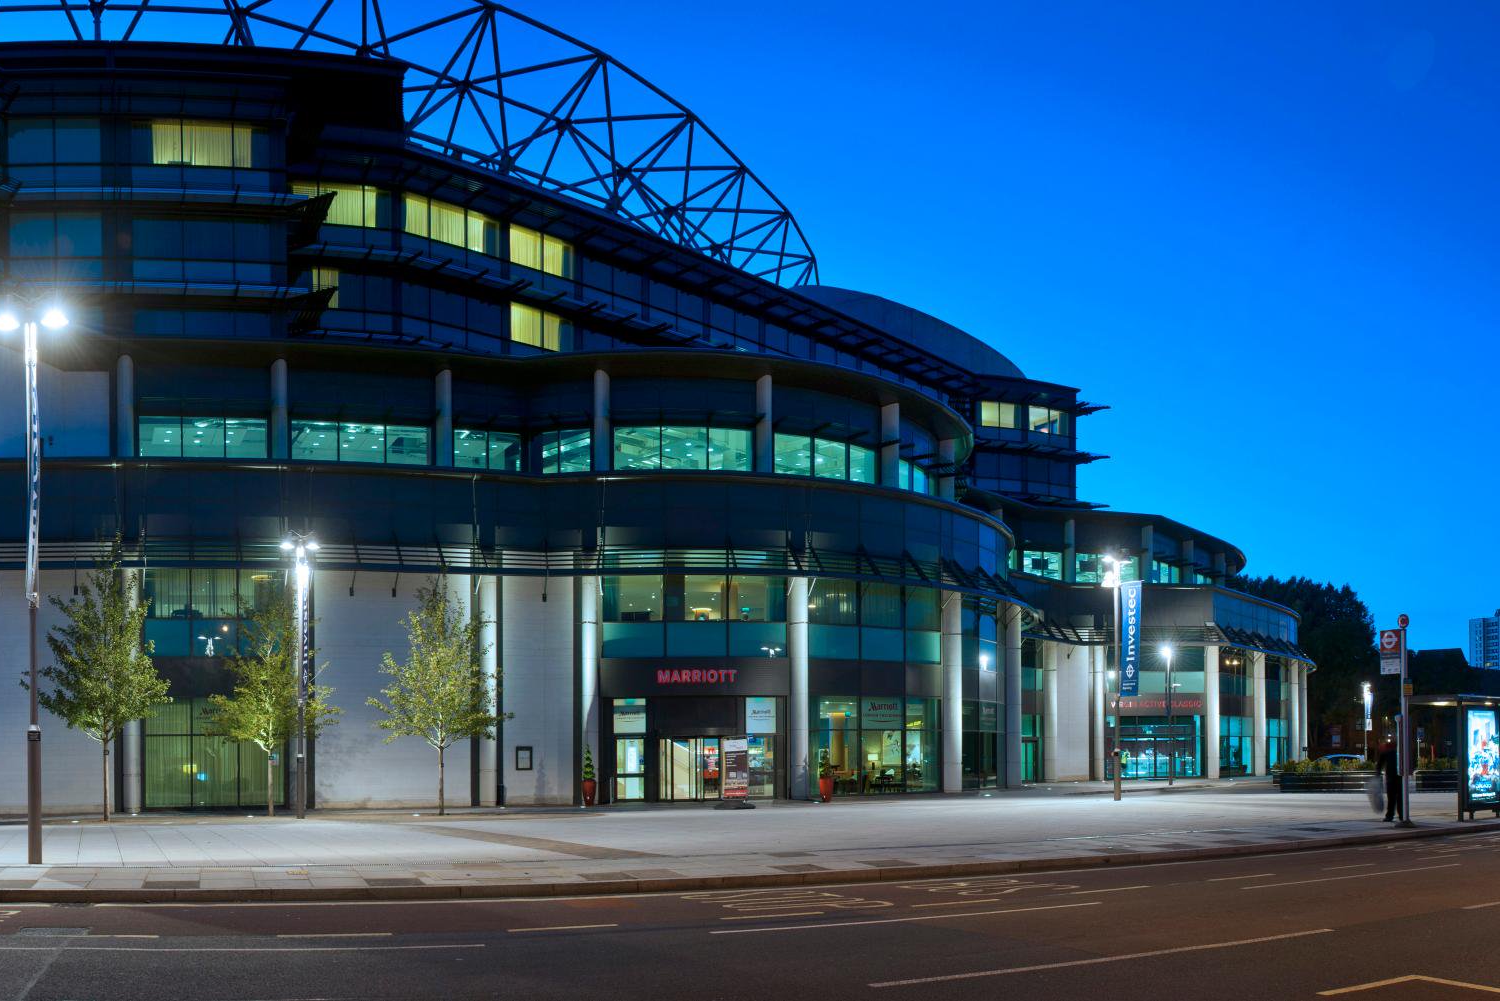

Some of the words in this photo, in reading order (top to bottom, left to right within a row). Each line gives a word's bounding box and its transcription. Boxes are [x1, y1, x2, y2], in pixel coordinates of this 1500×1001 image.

[1126, 588, 1137, 662] Investec
[657, 669, 738, 684] MARRIOTT
[868, 702, 898, 711] Marriott
